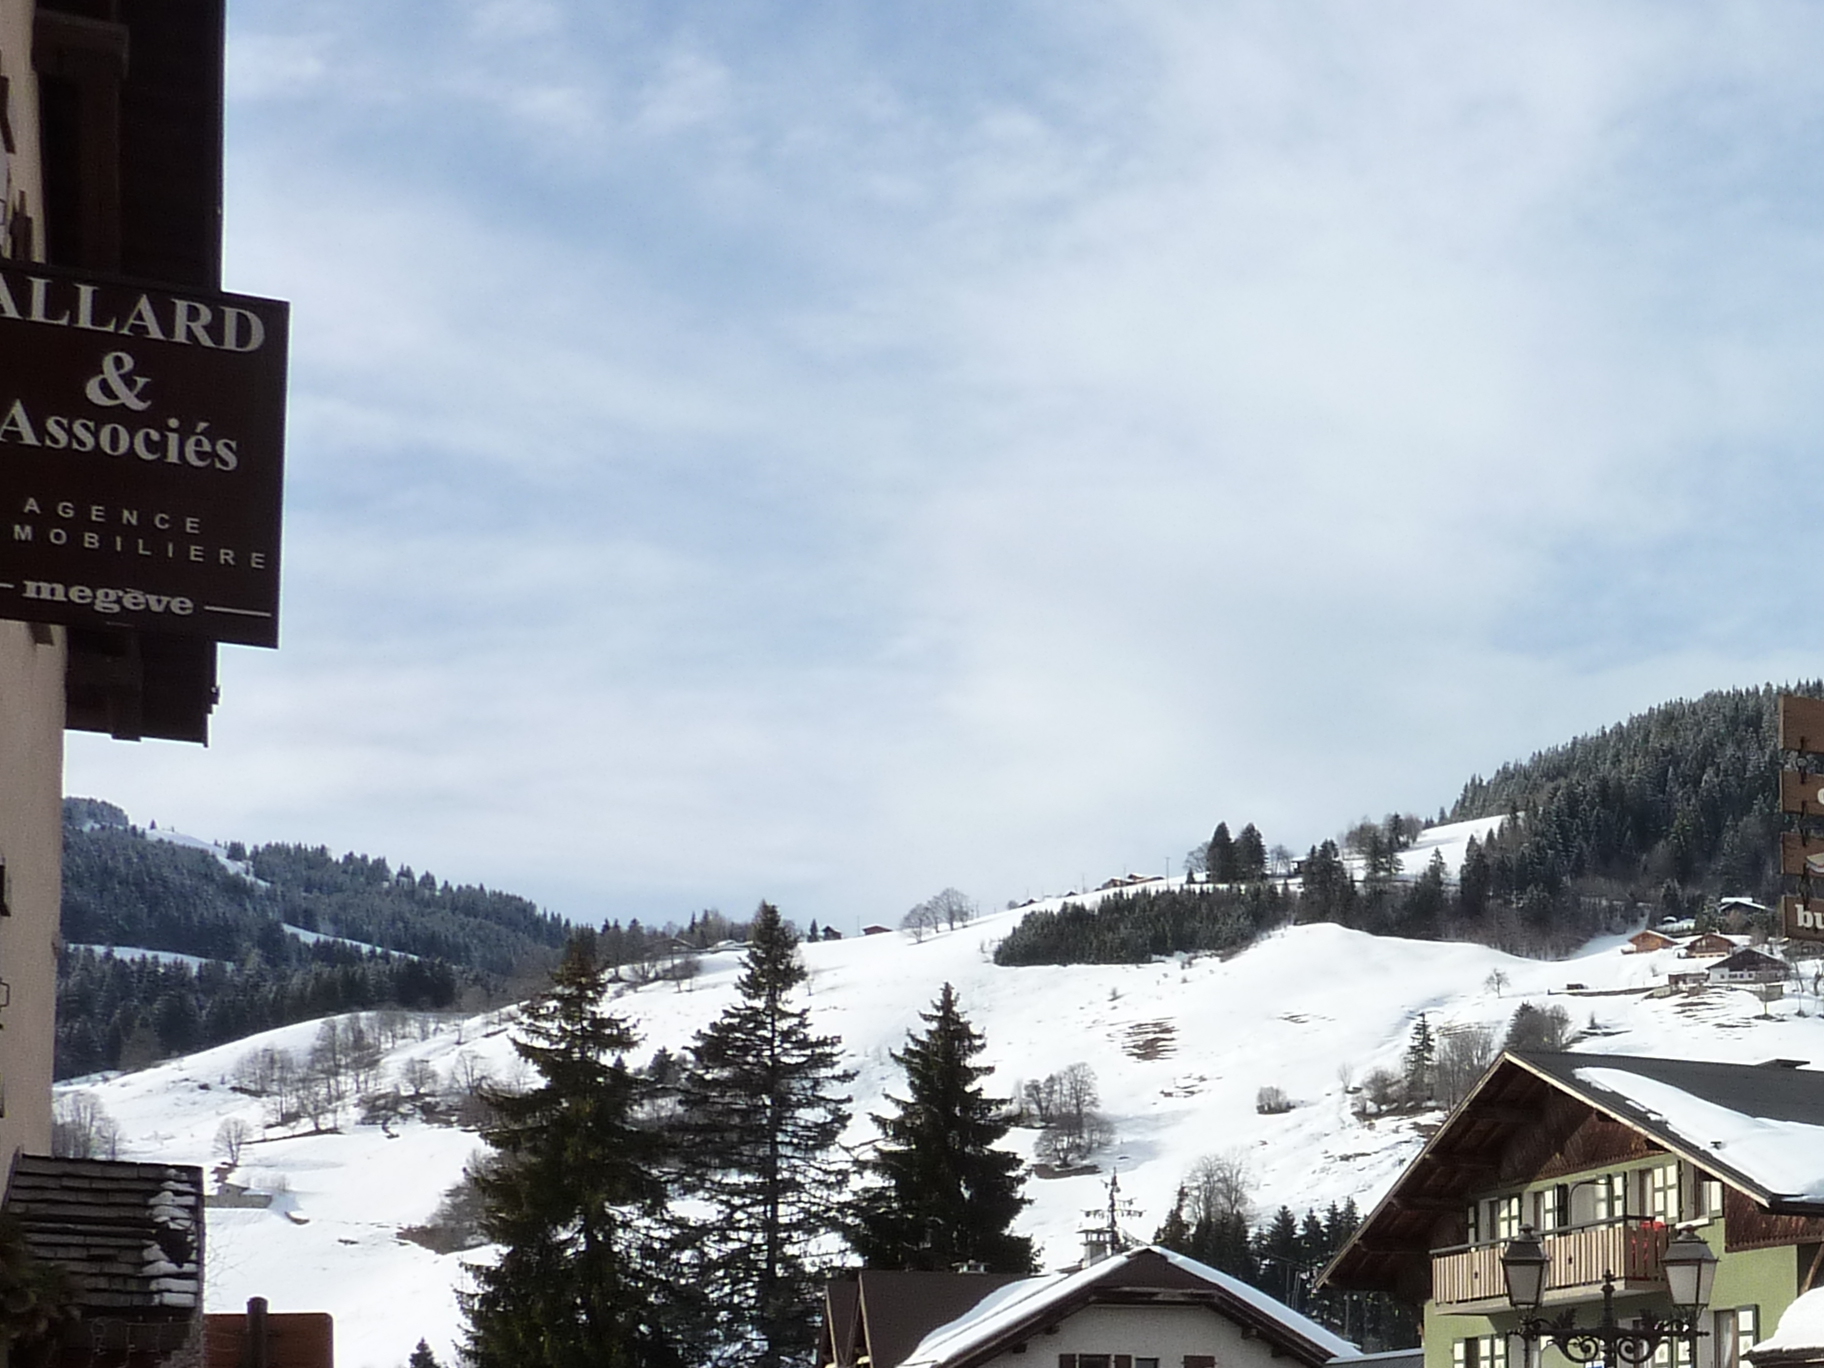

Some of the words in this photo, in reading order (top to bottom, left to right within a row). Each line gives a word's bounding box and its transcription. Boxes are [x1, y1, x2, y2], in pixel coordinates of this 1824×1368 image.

[86, 351, 152, 411] &
[0, 399, 238, 471] Associés
[24, 497, 201, 535] AGENCE
[22, 579, 194, 616] megève
